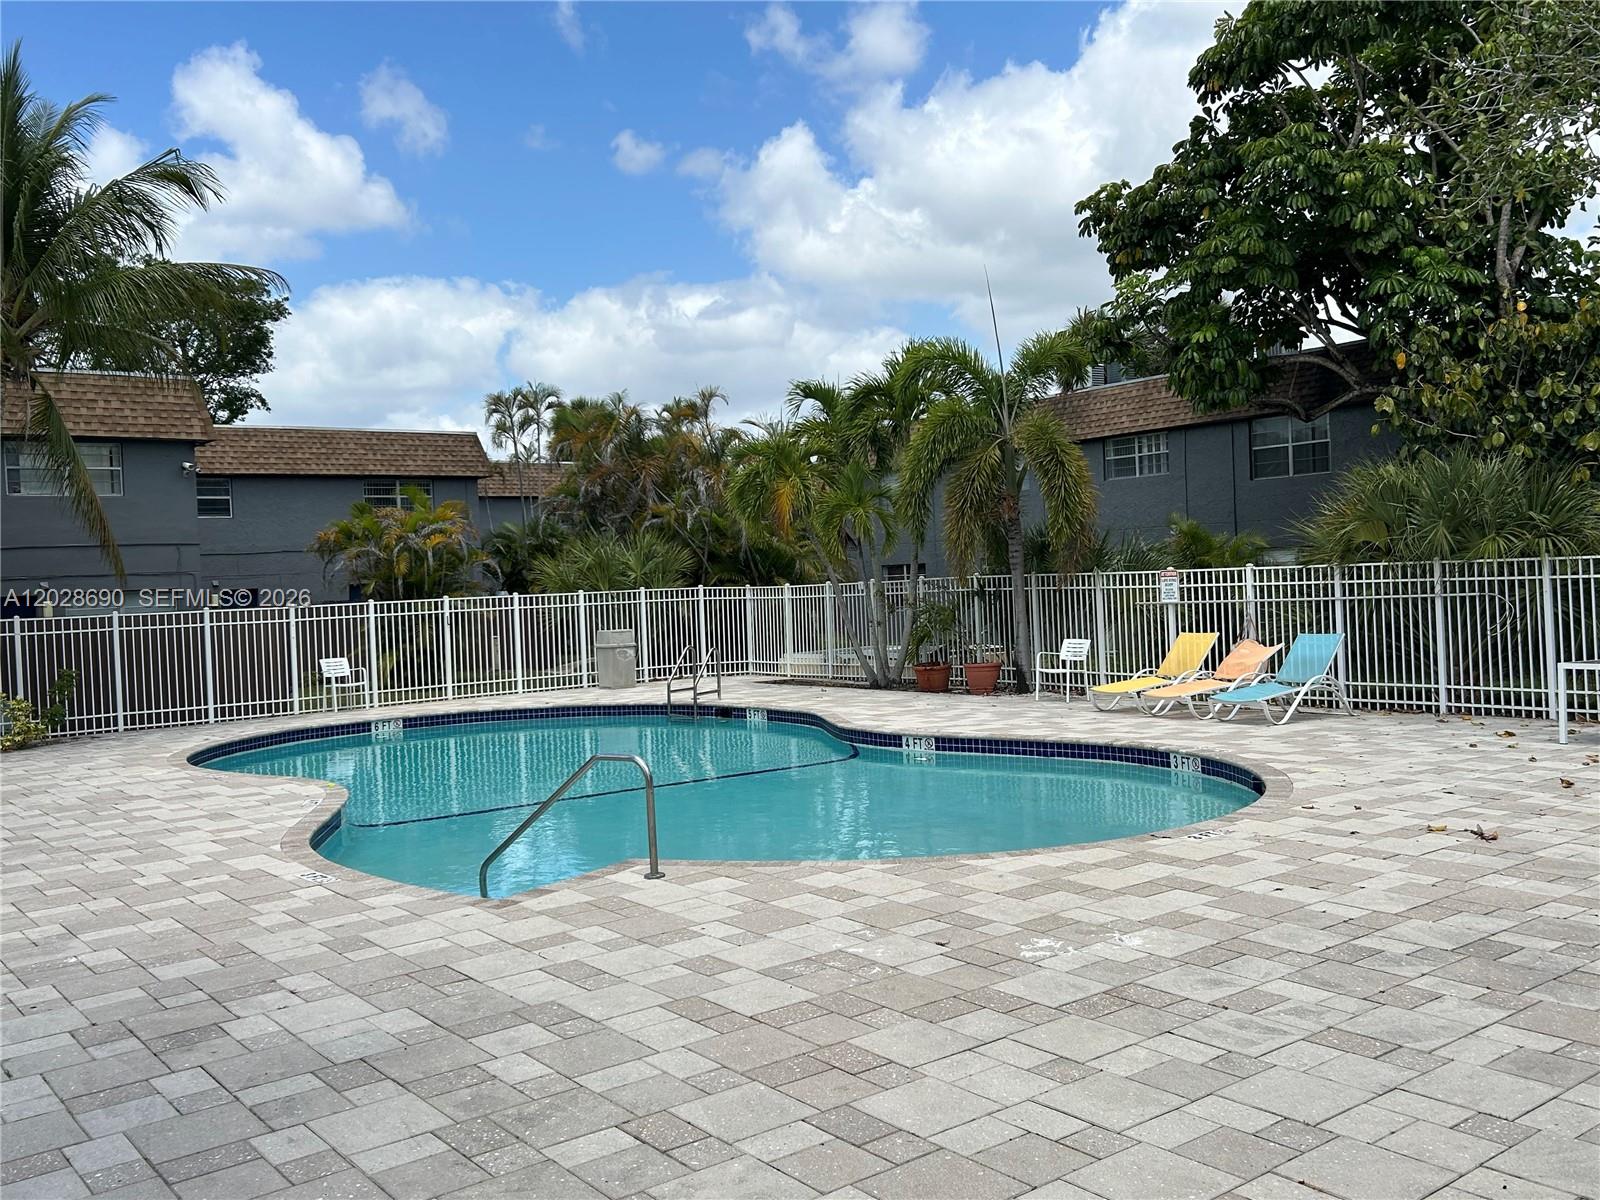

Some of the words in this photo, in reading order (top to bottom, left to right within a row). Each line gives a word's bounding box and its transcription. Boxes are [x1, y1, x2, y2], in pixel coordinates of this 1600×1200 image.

[374, 721, 380, 731] 6
[382, 720, 391, 730] FT
[905, 737, 910, 749] 4
[913, 737, 922, 749] FT
[1173, 755, 1179, 769] 3
[1181, 756, 1190, 770] FT
